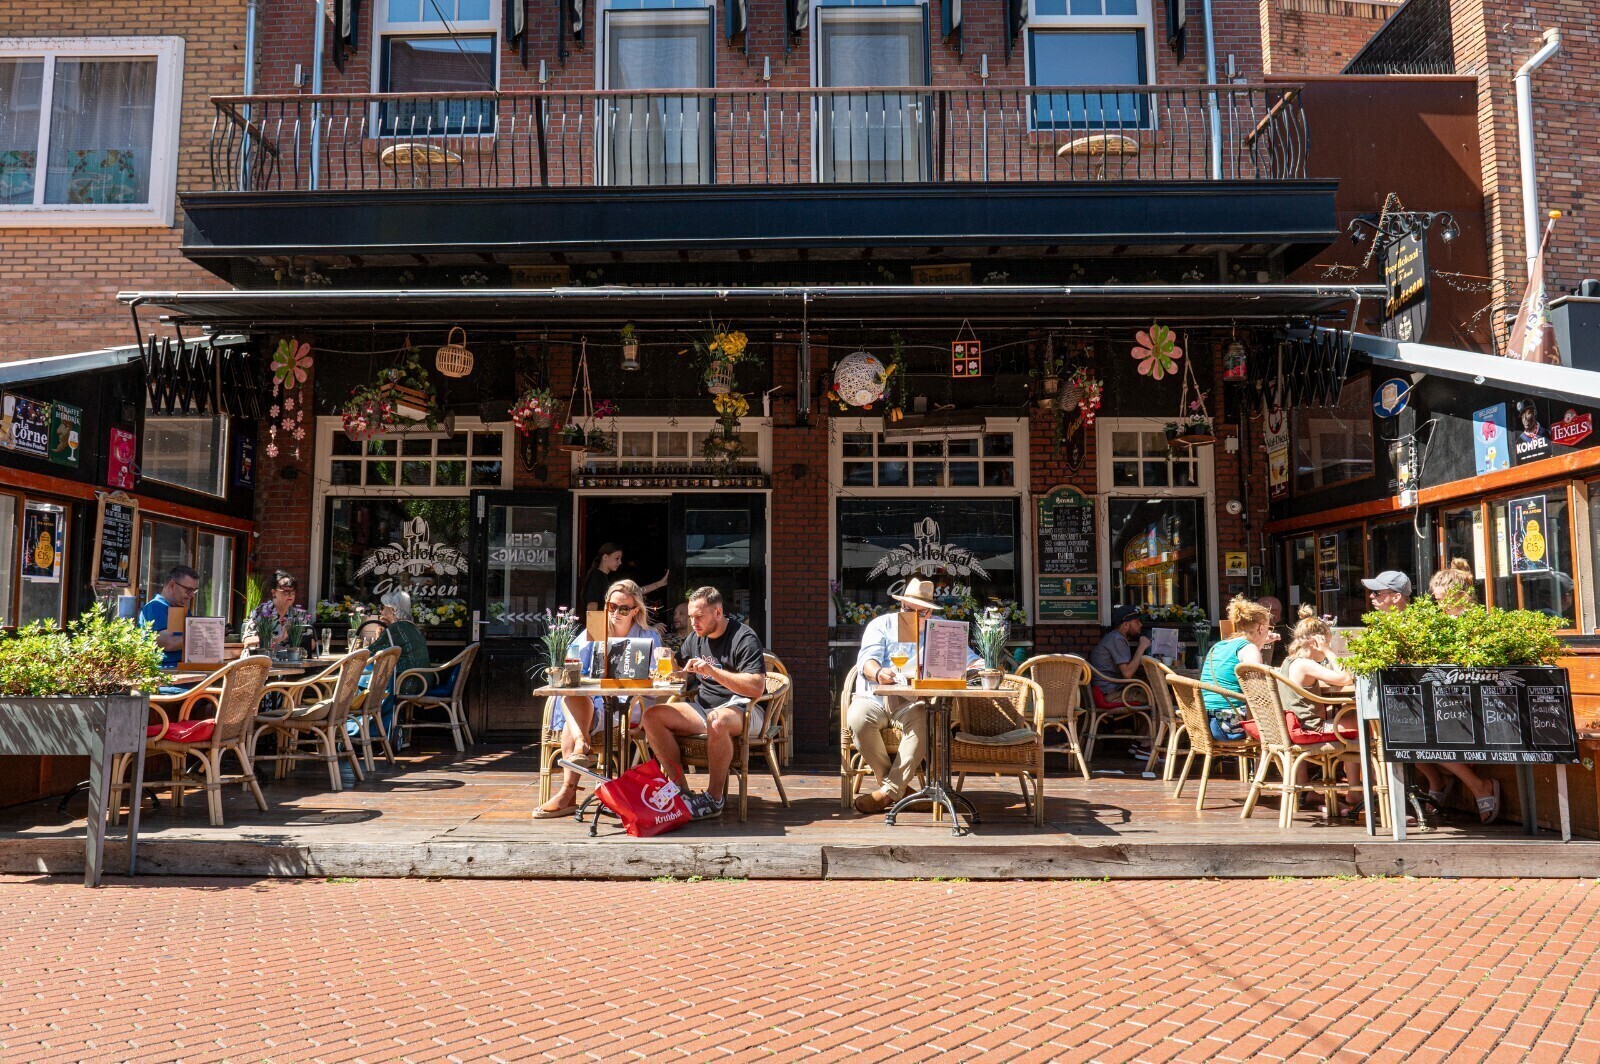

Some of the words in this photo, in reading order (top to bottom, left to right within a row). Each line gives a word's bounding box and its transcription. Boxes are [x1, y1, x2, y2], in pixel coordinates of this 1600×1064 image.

[1385, 248, 1419, 276] Proeflokaal
[58, 404, 79, 417] STRAFFE
[21, 420, 29, 430] La
[56, 411, 80, 426] HENDRIK
[12, 422, 47, 444] Corne
[1552, 421, 1588, 440] TEXELS
[1516, 437, 1548, 454] KOMPEL
[1055, 496, 1074, 504] Brand
[886, 579, 972, 597] Gssen
[623, 640, 632, 675] DRANKEN
[1446, 669, 1499, 683] Gorissen
[1412, 687, 1416, 695] 1
[1462, 687, 1467, 695] 2
[1509, 687, 1514, 695] 3
[1534, 716, 1557, 728] Blond
[1395, 750, 1411, 759] ONZE
[1415, 750, 1457, 760] SPECIAALBIER
[1463, 751, 1487, 761] KRANEN
[1491, 752, 1518, 762] WISSELEN
